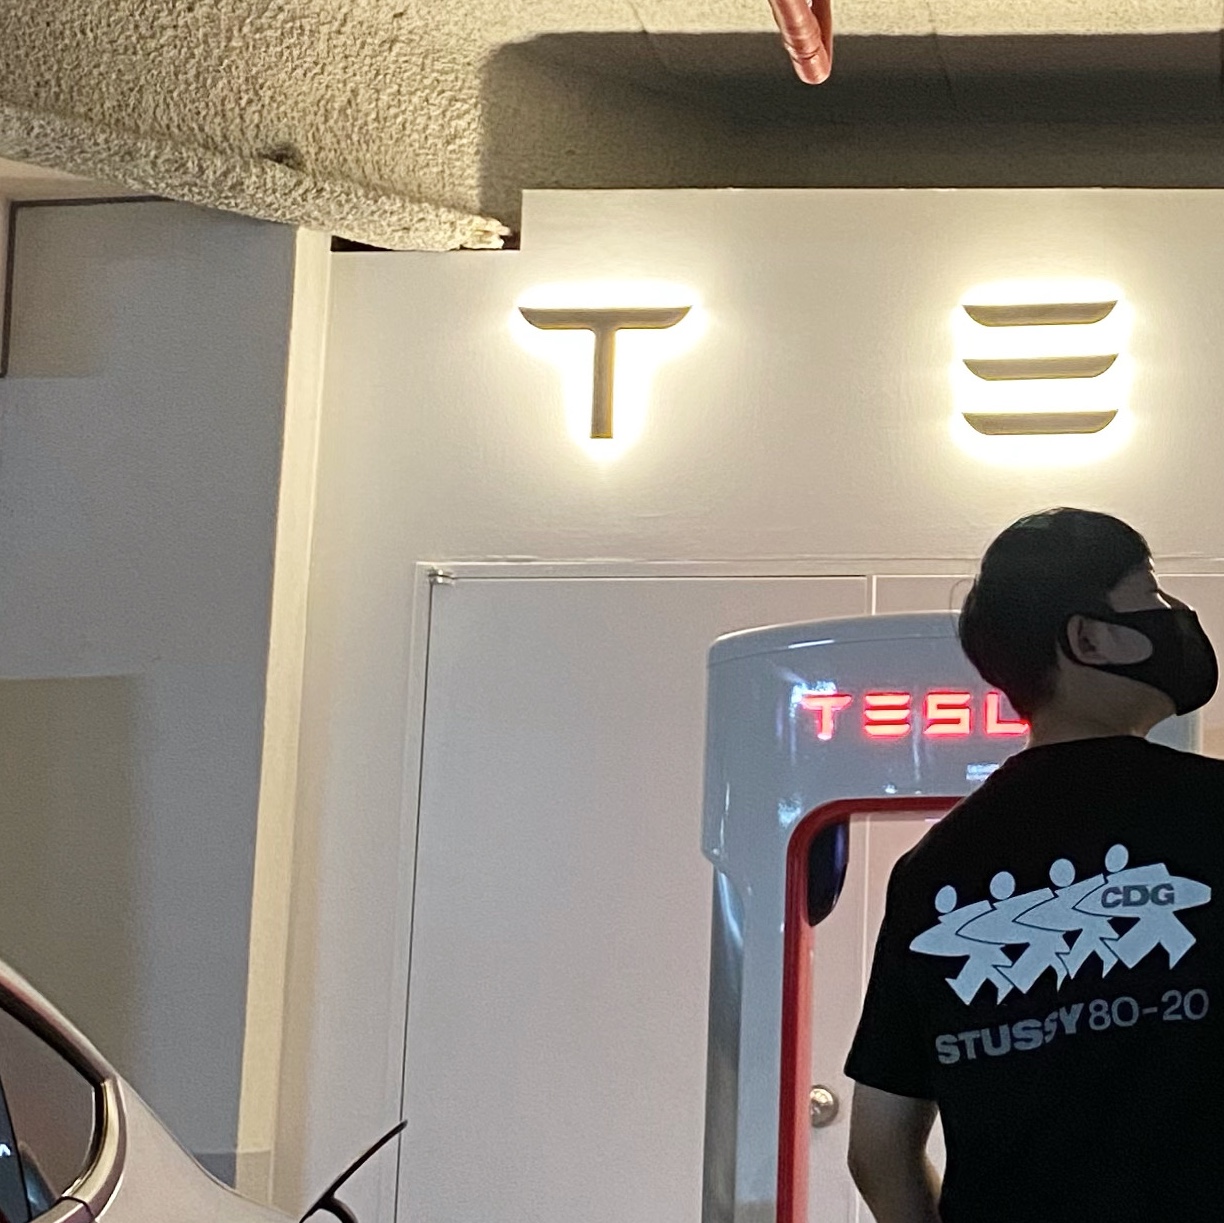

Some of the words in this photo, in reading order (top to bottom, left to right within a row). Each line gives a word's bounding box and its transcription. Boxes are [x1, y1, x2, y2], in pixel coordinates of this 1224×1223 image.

[1100, 883, 1175, 908] CDG
[935, 1002, 1085, 1064] STUSSY
[1087, 988, 1209, 1031] 80-20
